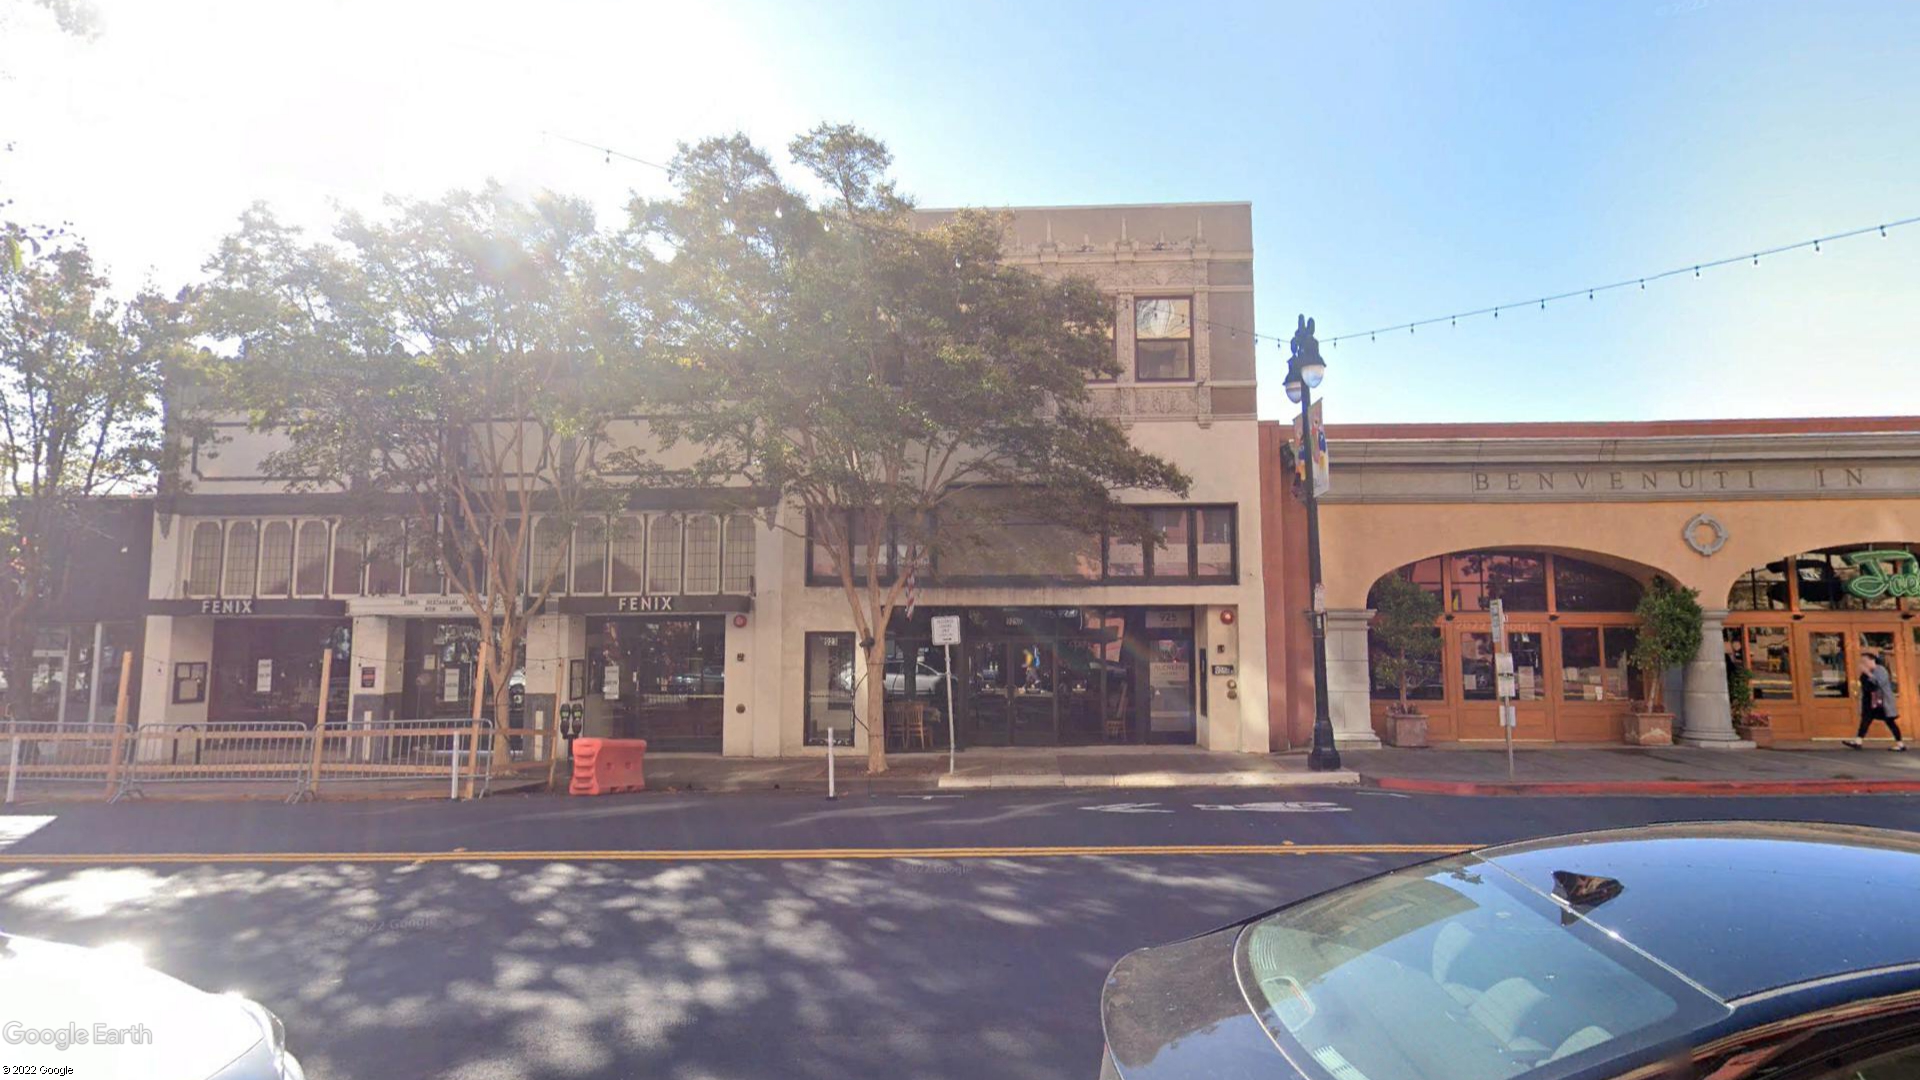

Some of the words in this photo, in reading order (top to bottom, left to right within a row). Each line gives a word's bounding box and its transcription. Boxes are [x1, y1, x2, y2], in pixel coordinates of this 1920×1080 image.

[1475, 470, 1755, 491] BENVENUTI
[1817, 468, 1863, 487] IN
[201, 600, 252, 614] FENIX
[619, 597, 672, 611] FENIX
